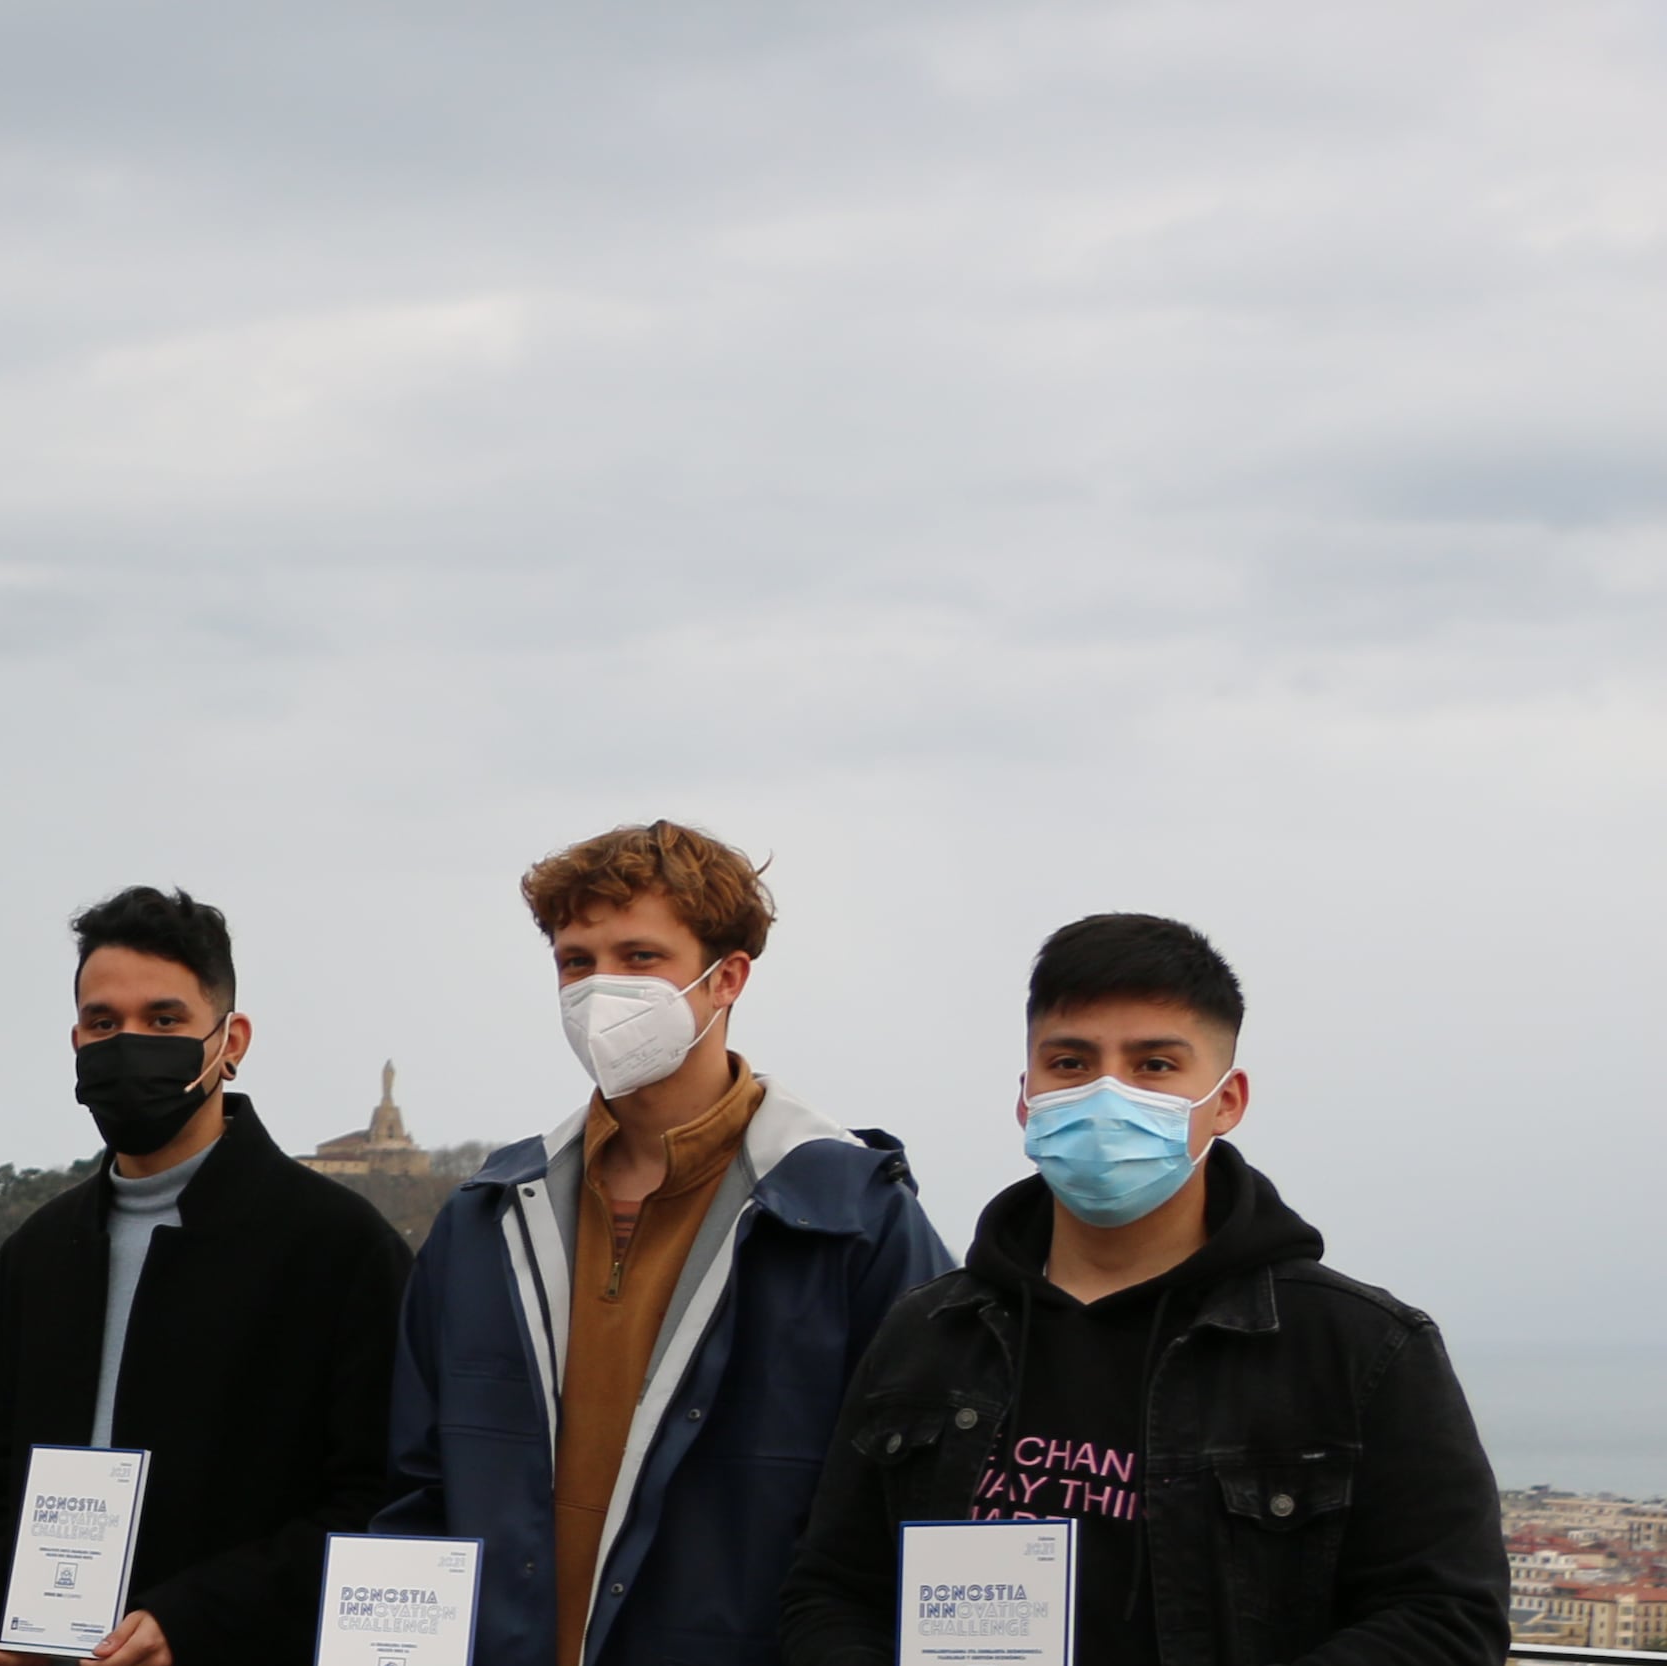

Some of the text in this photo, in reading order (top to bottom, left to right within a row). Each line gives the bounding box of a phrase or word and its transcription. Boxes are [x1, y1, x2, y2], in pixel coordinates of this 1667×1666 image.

[1014, 1436, 1134, 1482] CHAN
[35, 1495, 107, 1512] DONOSTIA
[33, 1510, 119, 1528] INNOVATION
[31, 1524, 105, 1541] CHALLENGE
[341, 1587, 438, 1604] DONOSTIA
[920, 1584, 1027, 1601] DONOSTIA
[339, 1602, 457, 1620] INNOVATION
[919, 1601, 1049, 1619] INNOVATION
[338, 1616, 439, 1634] CHALLENGE
[918, 1619, 1029, 1636] CHALLENGE
